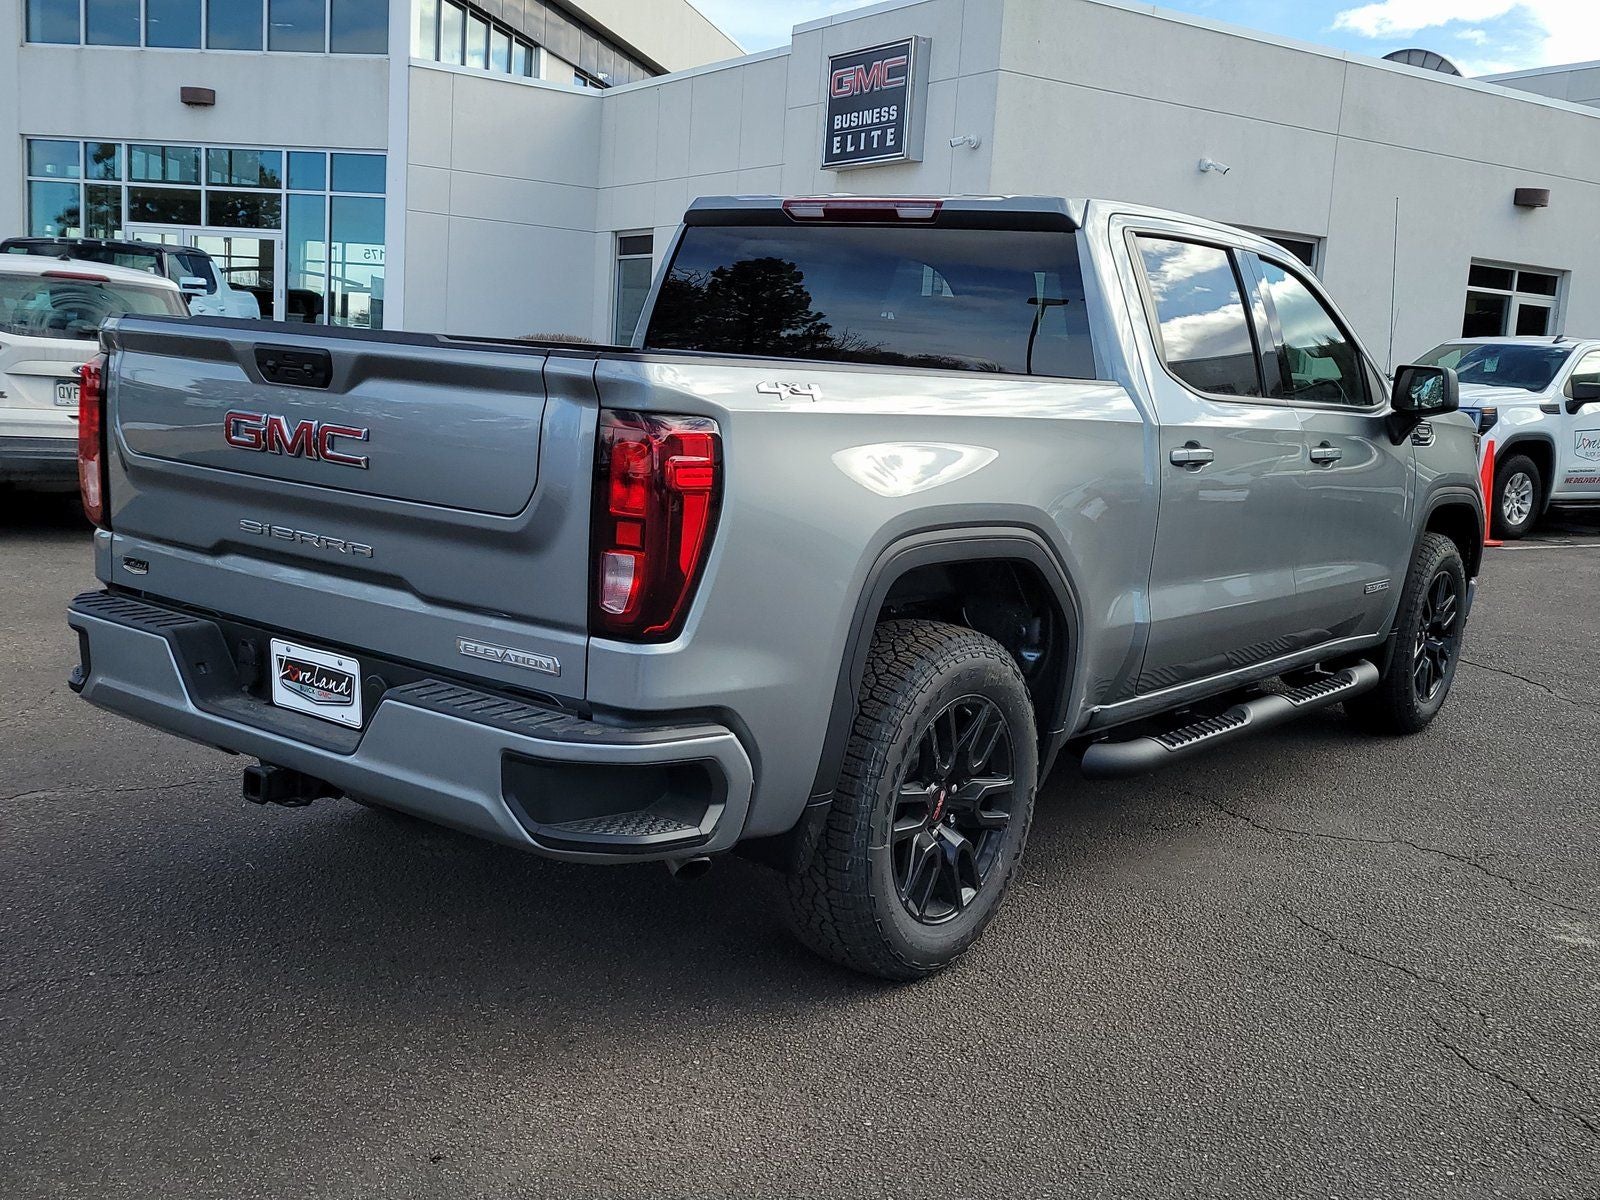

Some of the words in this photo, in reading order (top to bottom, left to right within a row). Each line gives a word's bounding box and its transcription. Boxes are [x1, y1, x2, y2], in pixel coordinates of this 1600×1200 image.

[831, 55, 907, 99] GMC
[834, 105, 898, 130] BUSINESS
[832, 128, 896, 154] ELITE
[224, 409, 370, 470] GMC
[240, 519, 374, 558] SIERRA
[463, 643, 552, 670] ELEVATION
